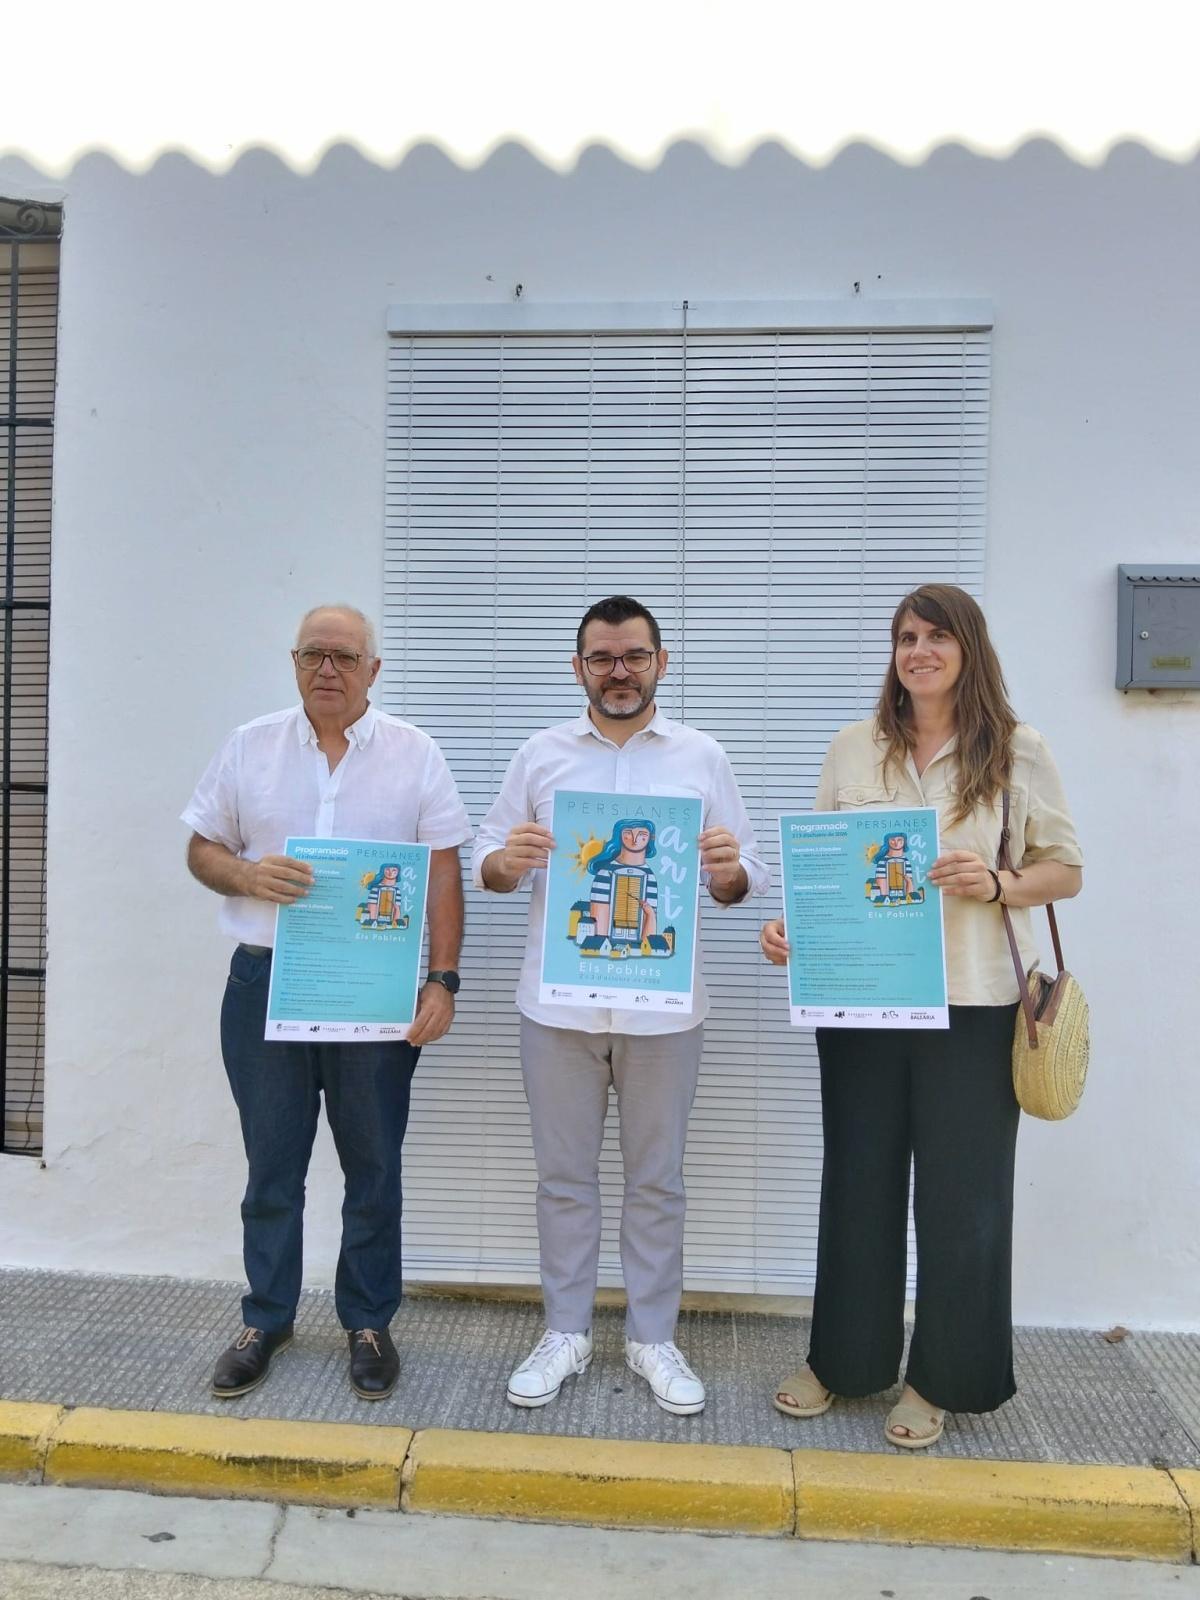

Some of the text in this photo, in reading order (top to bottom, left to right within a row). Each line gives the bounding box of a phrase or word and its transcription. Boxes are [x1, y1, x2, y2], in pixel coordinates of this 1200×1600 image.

[567, 801, 692, 820] PERSIANES
[857, 818, 928, 829] PERSIANES
[356, 848, 421, 861] PERSIANES
[909, 834, 927, 884] art
[659, 826, 688, 919] art
[402, 866, 417, 912] art
[868, 911, 882, 919] Els
[579, 961, 662, 977] Els Poblets
